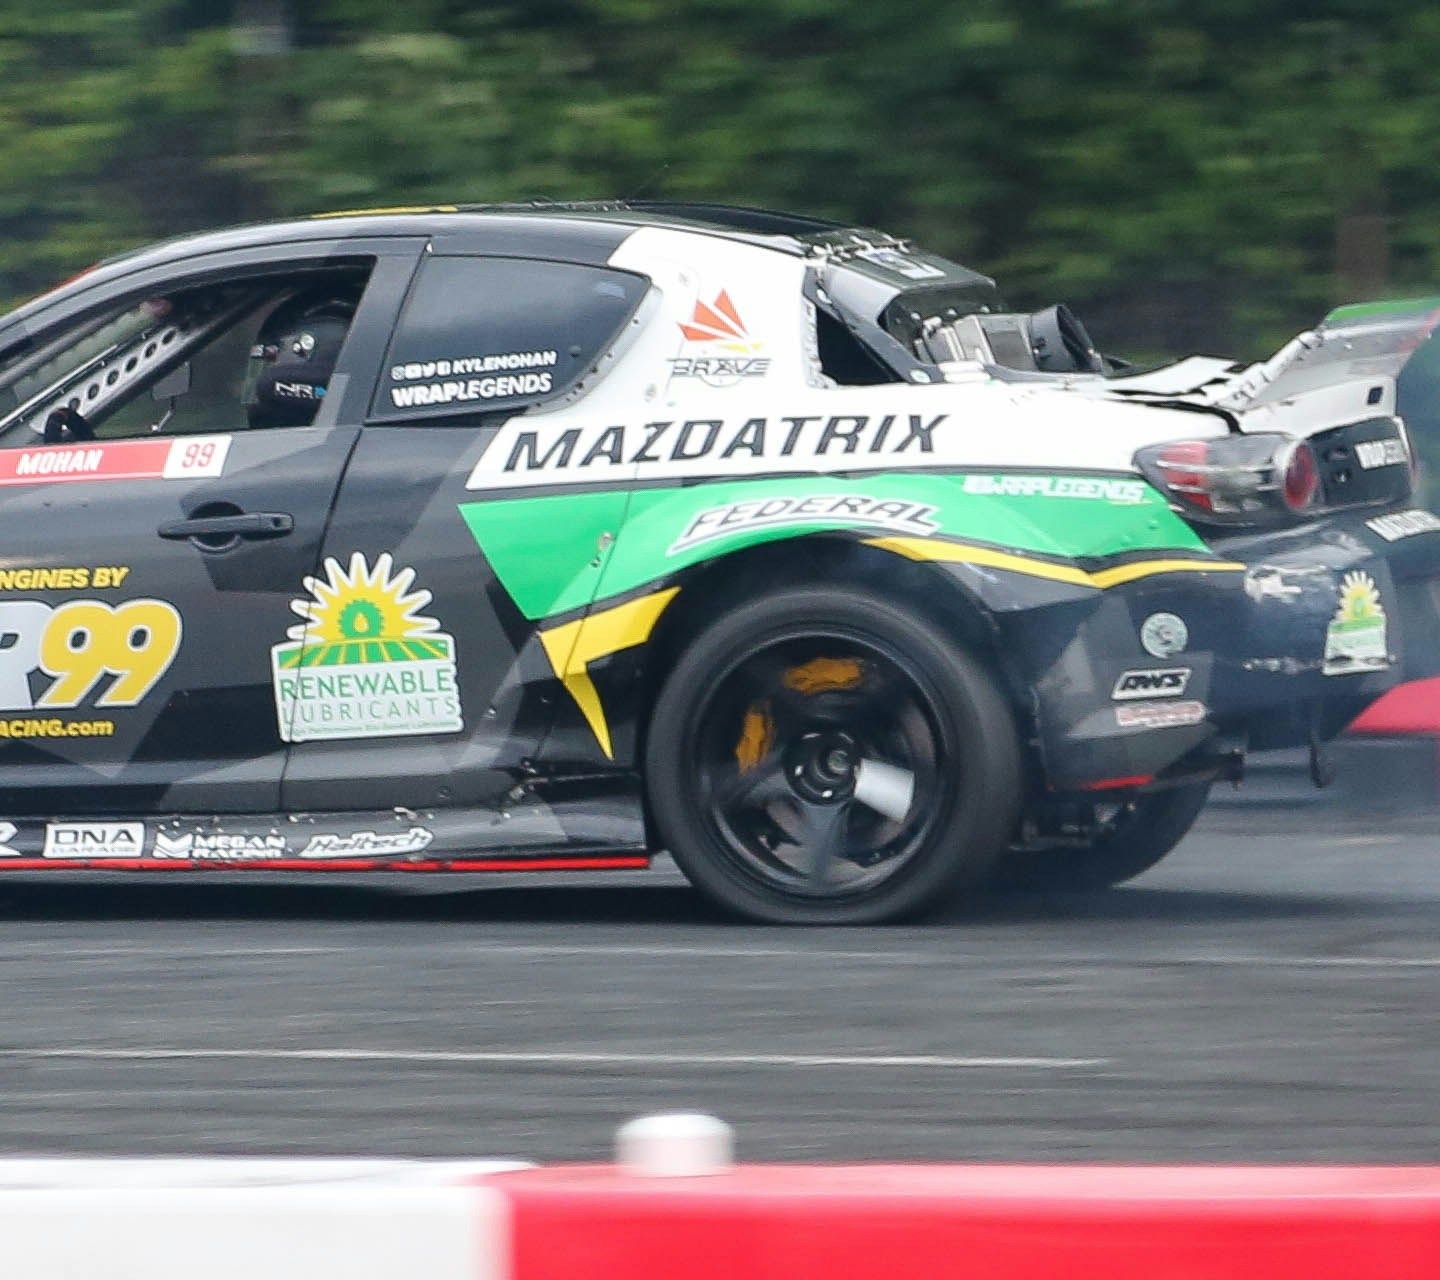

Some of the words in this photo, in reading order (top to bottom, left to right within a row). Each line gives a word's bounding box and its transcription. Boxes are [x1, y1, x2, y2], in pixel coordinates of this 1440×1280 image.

[666, 357, 771, 377] BRAVE
[392, 372, 553, 408] WRAPLEGENDS
[16, 449, 104, 476] MOHAN
[182, 442, 217, 469] 99
[502, 413, 950, 474] MAZDATRIX
[682, 496, 942, 538] FEDERAL
[90, 566, 130, 589] BY
[278, 668, 454, 702] RENEWABLE
[281, 695, 458, 726] LUBRICANTS
[53, 828, 138, 845] DNA
[193, 834, 287, 850] MEGAN
[306, 827, 433, 856] Haltech
